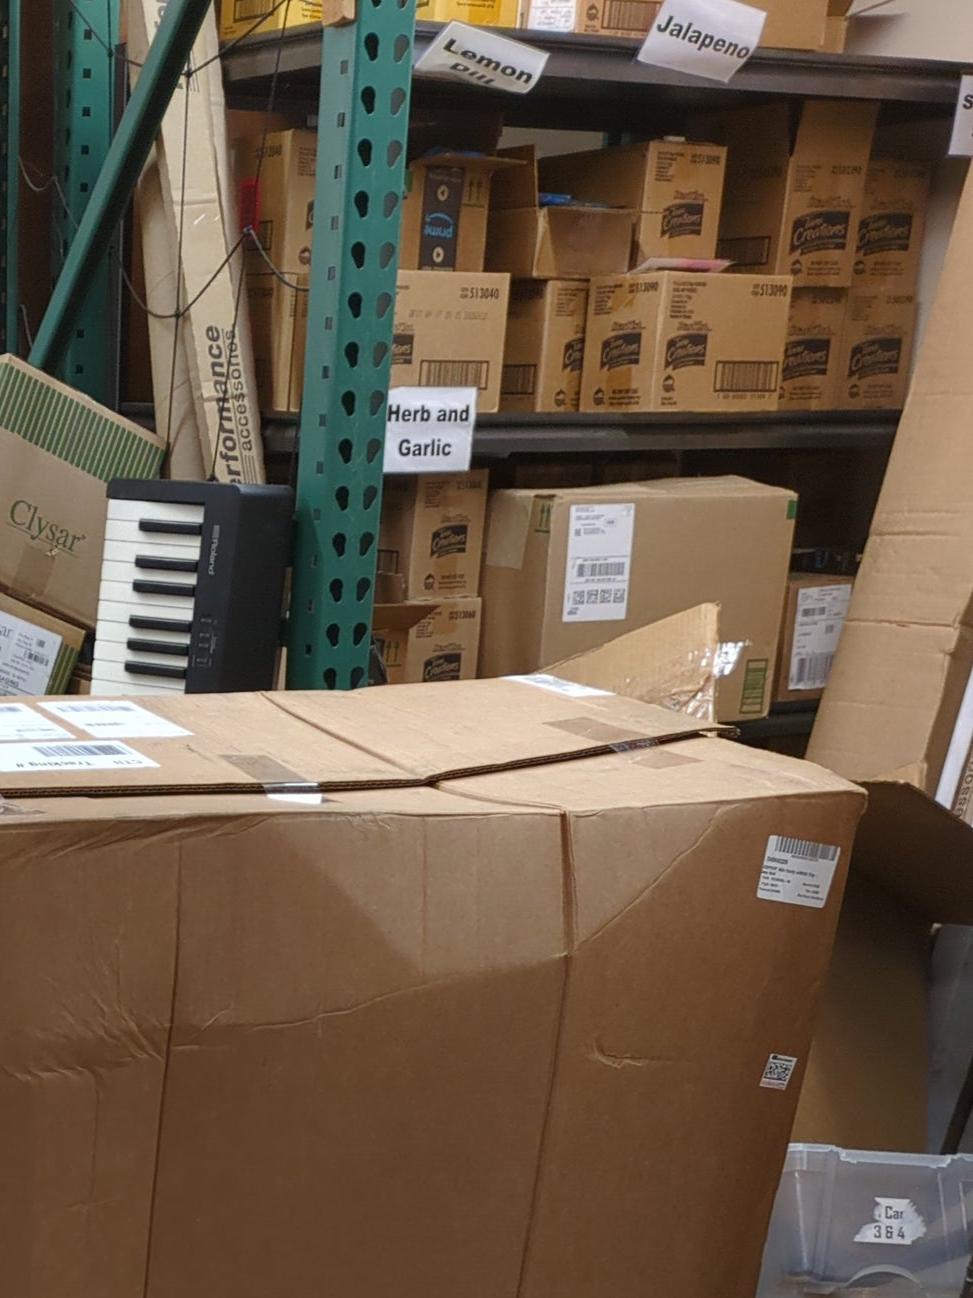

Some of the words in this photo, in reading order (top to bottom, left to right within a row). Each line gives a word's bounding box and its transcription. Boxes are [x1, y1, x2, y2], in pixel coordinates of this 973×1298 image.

[657, 15, 752, 60] Jalapeno
[443, 38, 533, 84] Lemon
[450, 62, 495, 84] Dill
[793, 224, 846, 245] Creations
[469, 287, 499, 300] 513040
[760, 284, 788, 297] 513090
[224, 329, 253, 452] accessories
[387, 404, 430, 422] Herb
[437, 404, 470, 422] and
[398, 438, 452, 457] Garlic
[8, 499, 83, 553] Clysar
[208, 538, 219, 575] Roland
[884, 1205, 904, 1219] Car
[874, 1225, 881, 1238] 3
[897, 1226, 905, 1239] 4
